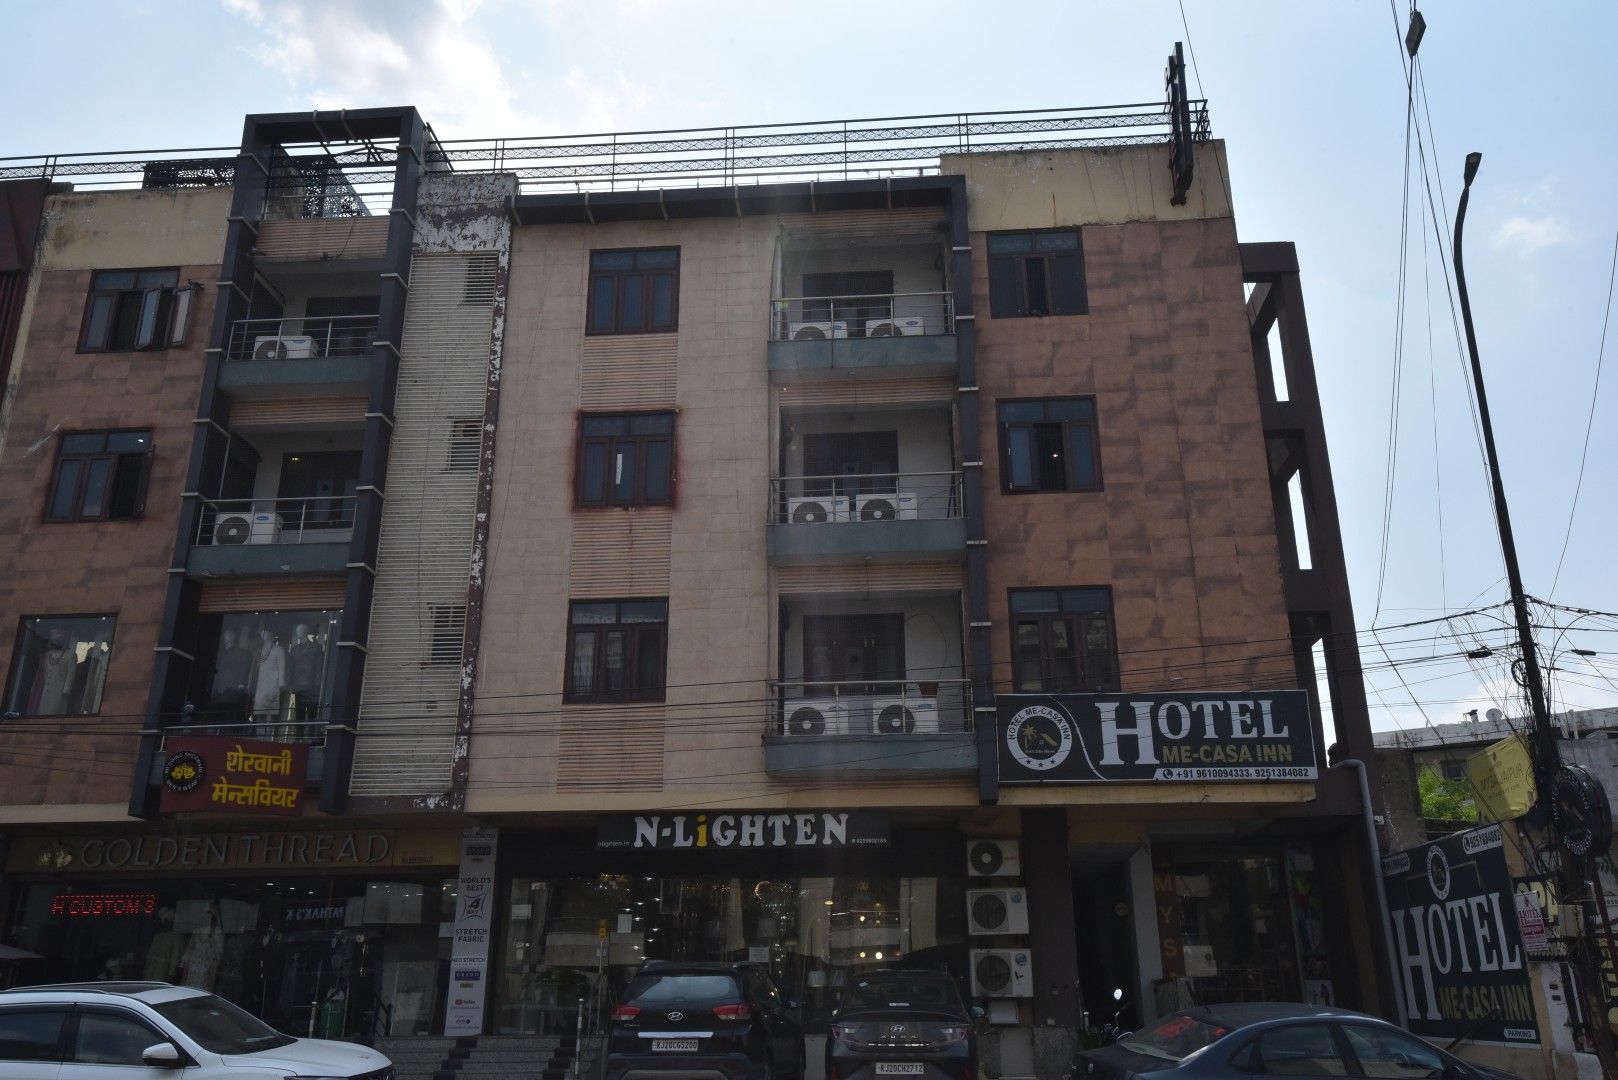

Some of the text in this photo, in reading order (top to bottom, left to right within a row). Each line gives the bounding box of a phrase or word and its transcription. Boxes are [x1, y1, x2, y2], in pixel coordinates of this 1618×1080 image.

[1095, 699, 1289, 766] HOTEL
[226, 744, 292, 776] शेरवानी
[1162, 743, 1293, 763] ME-CASA INN
[1176, 769, 1194, 778] +91
[1255, 768, 1309, 778] 9251384082
[212, 775, 300, 808] मेन्सवियर
[81, 833, 390, 868] GOLDEN THREAD
[468, 897, 481, 909] 4
[455, 928, 487, 936] STRETCH
[1392, 892, 1523, 1021] HOTEL
[1500, 985, 1533, 1021] INN
[1507, 1030, 1532, 1038] PARKING
